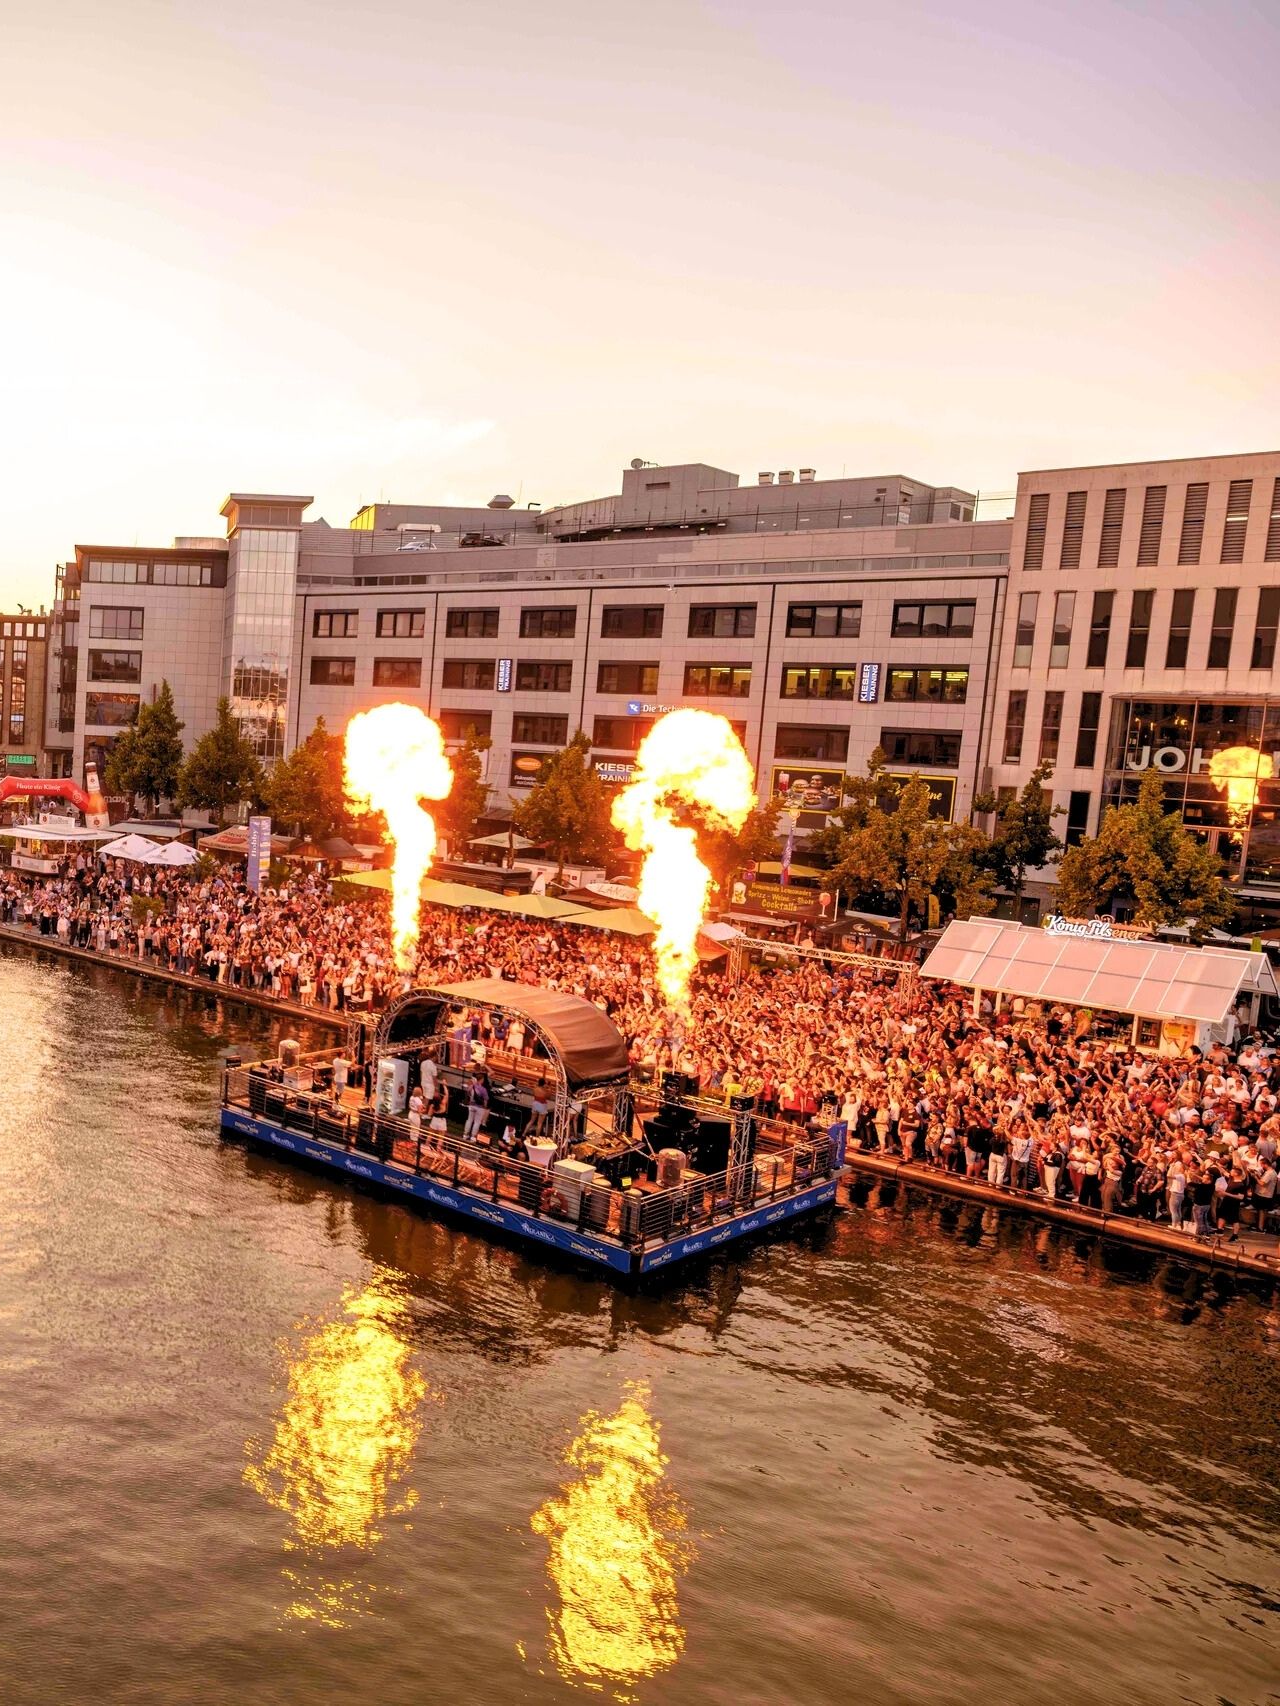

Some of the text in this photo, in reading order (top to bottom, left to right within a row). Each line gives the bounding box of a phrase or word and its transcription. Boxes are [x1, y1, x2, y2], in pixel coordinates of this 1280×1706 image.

[497, 659, 505, 691] KIESER
[860, 664, 879, 702] KIESER TRAINING
[642, 704, 657, 713] Die
[251, 829, 259, 857] Hobby
[761, 898, 798, 912] Cocktails
[1044, 914, 1143, 940] König Pilsener
